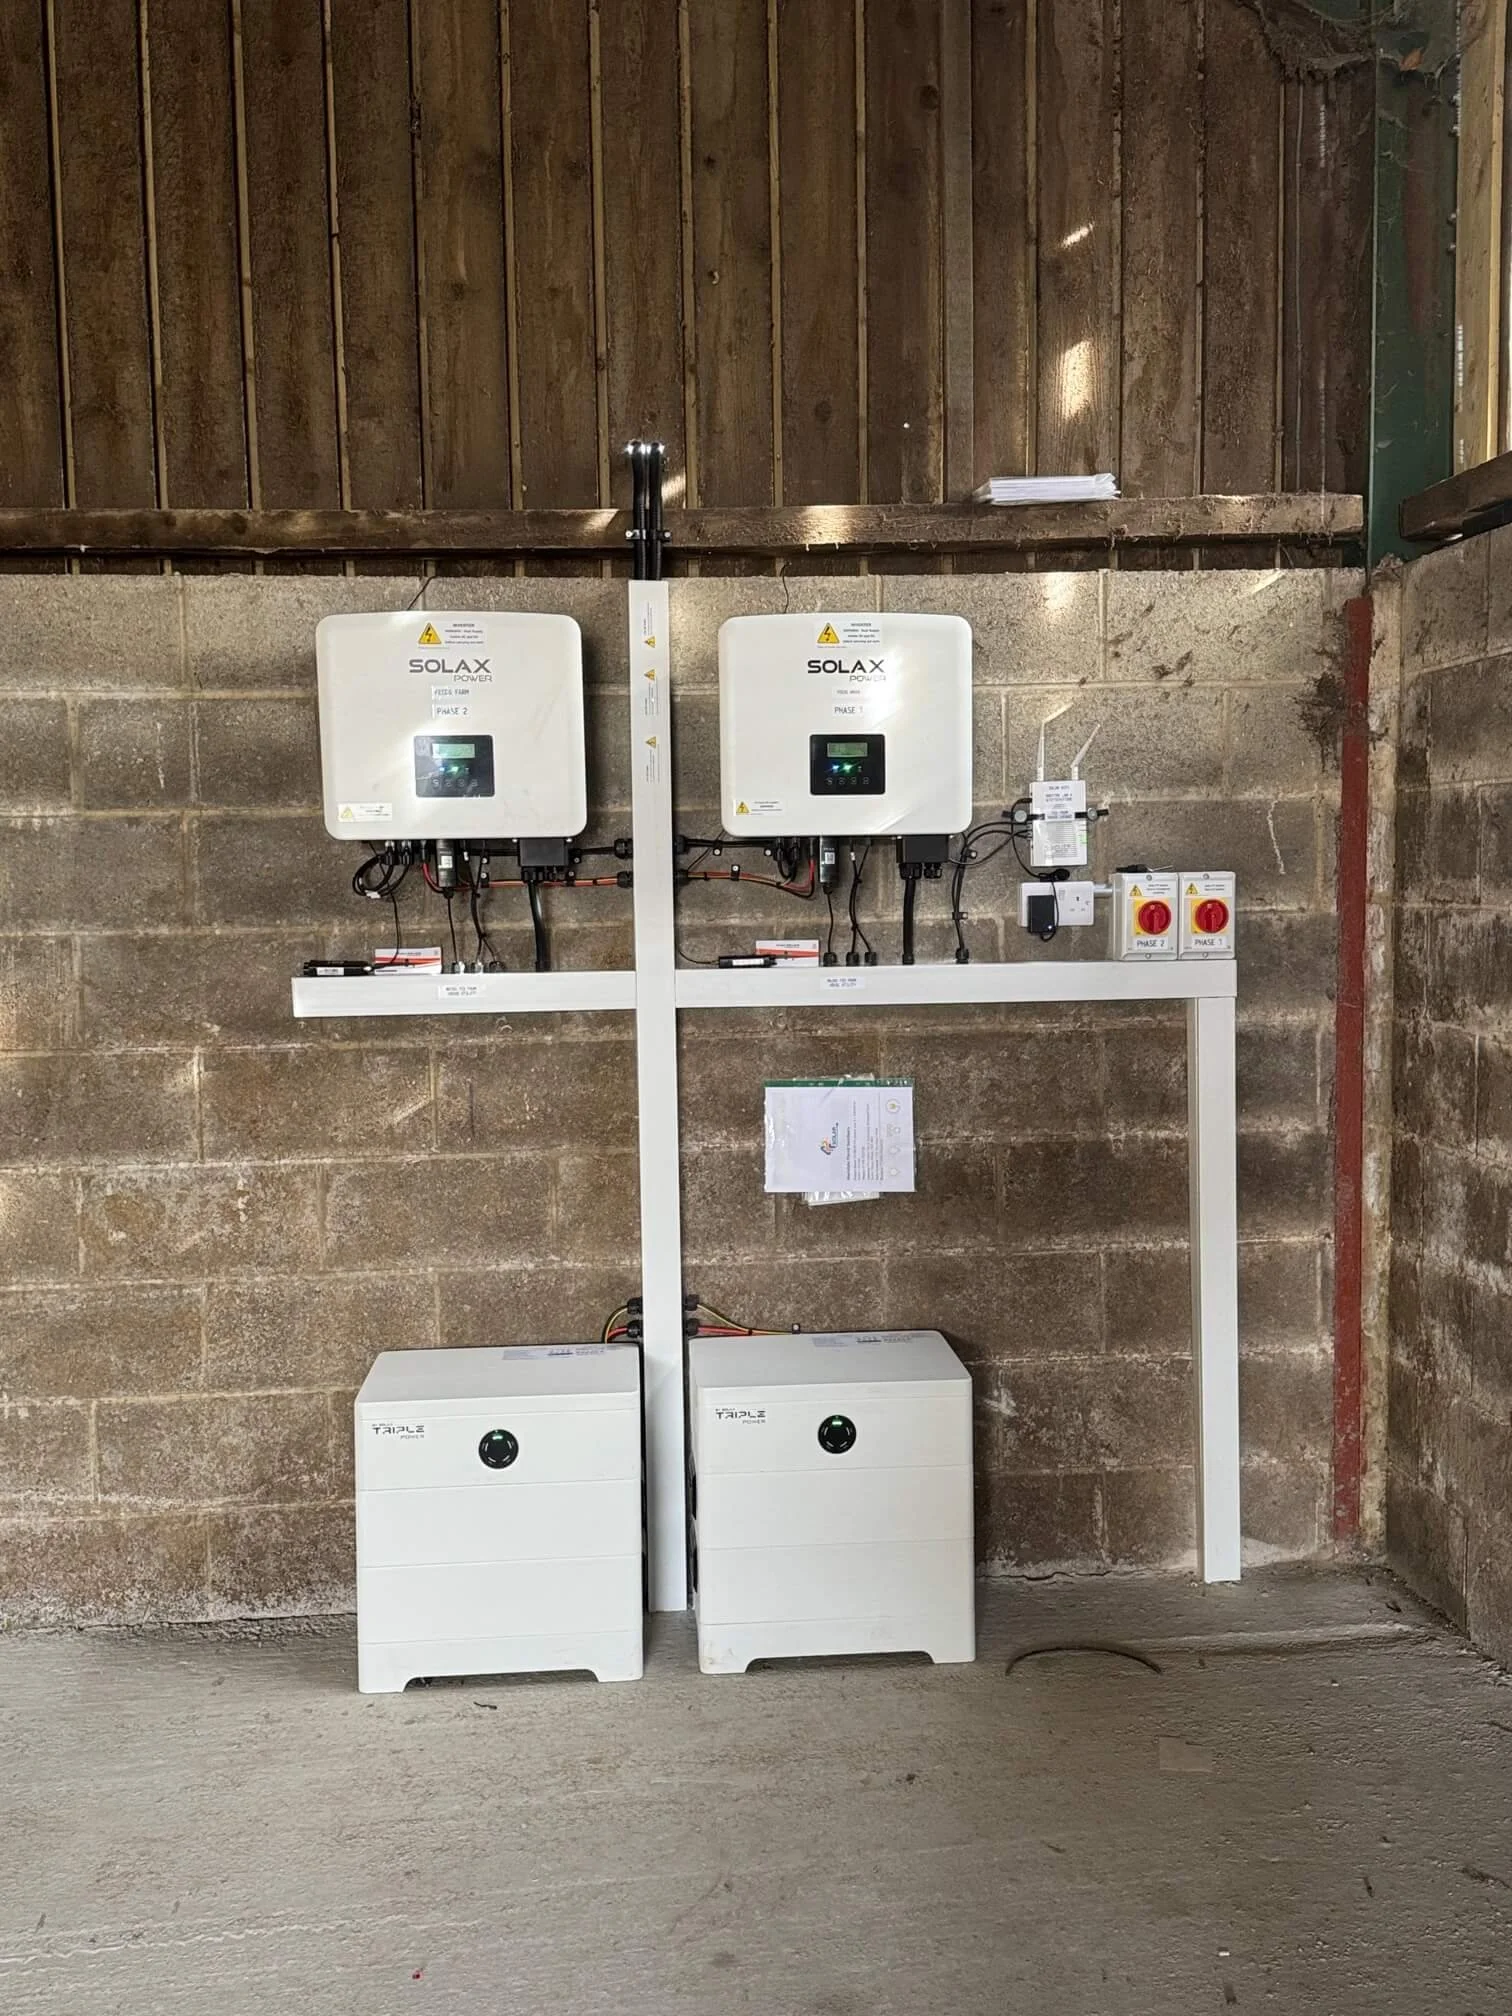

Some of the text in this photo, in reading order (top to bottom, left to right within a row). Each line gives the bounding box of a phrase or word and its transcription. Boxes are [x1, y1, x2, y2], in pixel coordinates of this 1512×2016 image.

[408, 658, 492, 674] SOLAX
[807, 659, 885, 674] SOLAX
[453, 674, 493, 682] POWER
[436, 706, 468, 715] PHASE 2
[834, 706, 856, 715] PHASE
[1136, 940, 1157, 948] PHASE
[1160, 940, 1165, 948] 2
[1194, 938, 1215, 946] PHASE
[716, 1411, 766, 1419] TRIPLE
[372, 1425, 424, 1434] TRIPLE
